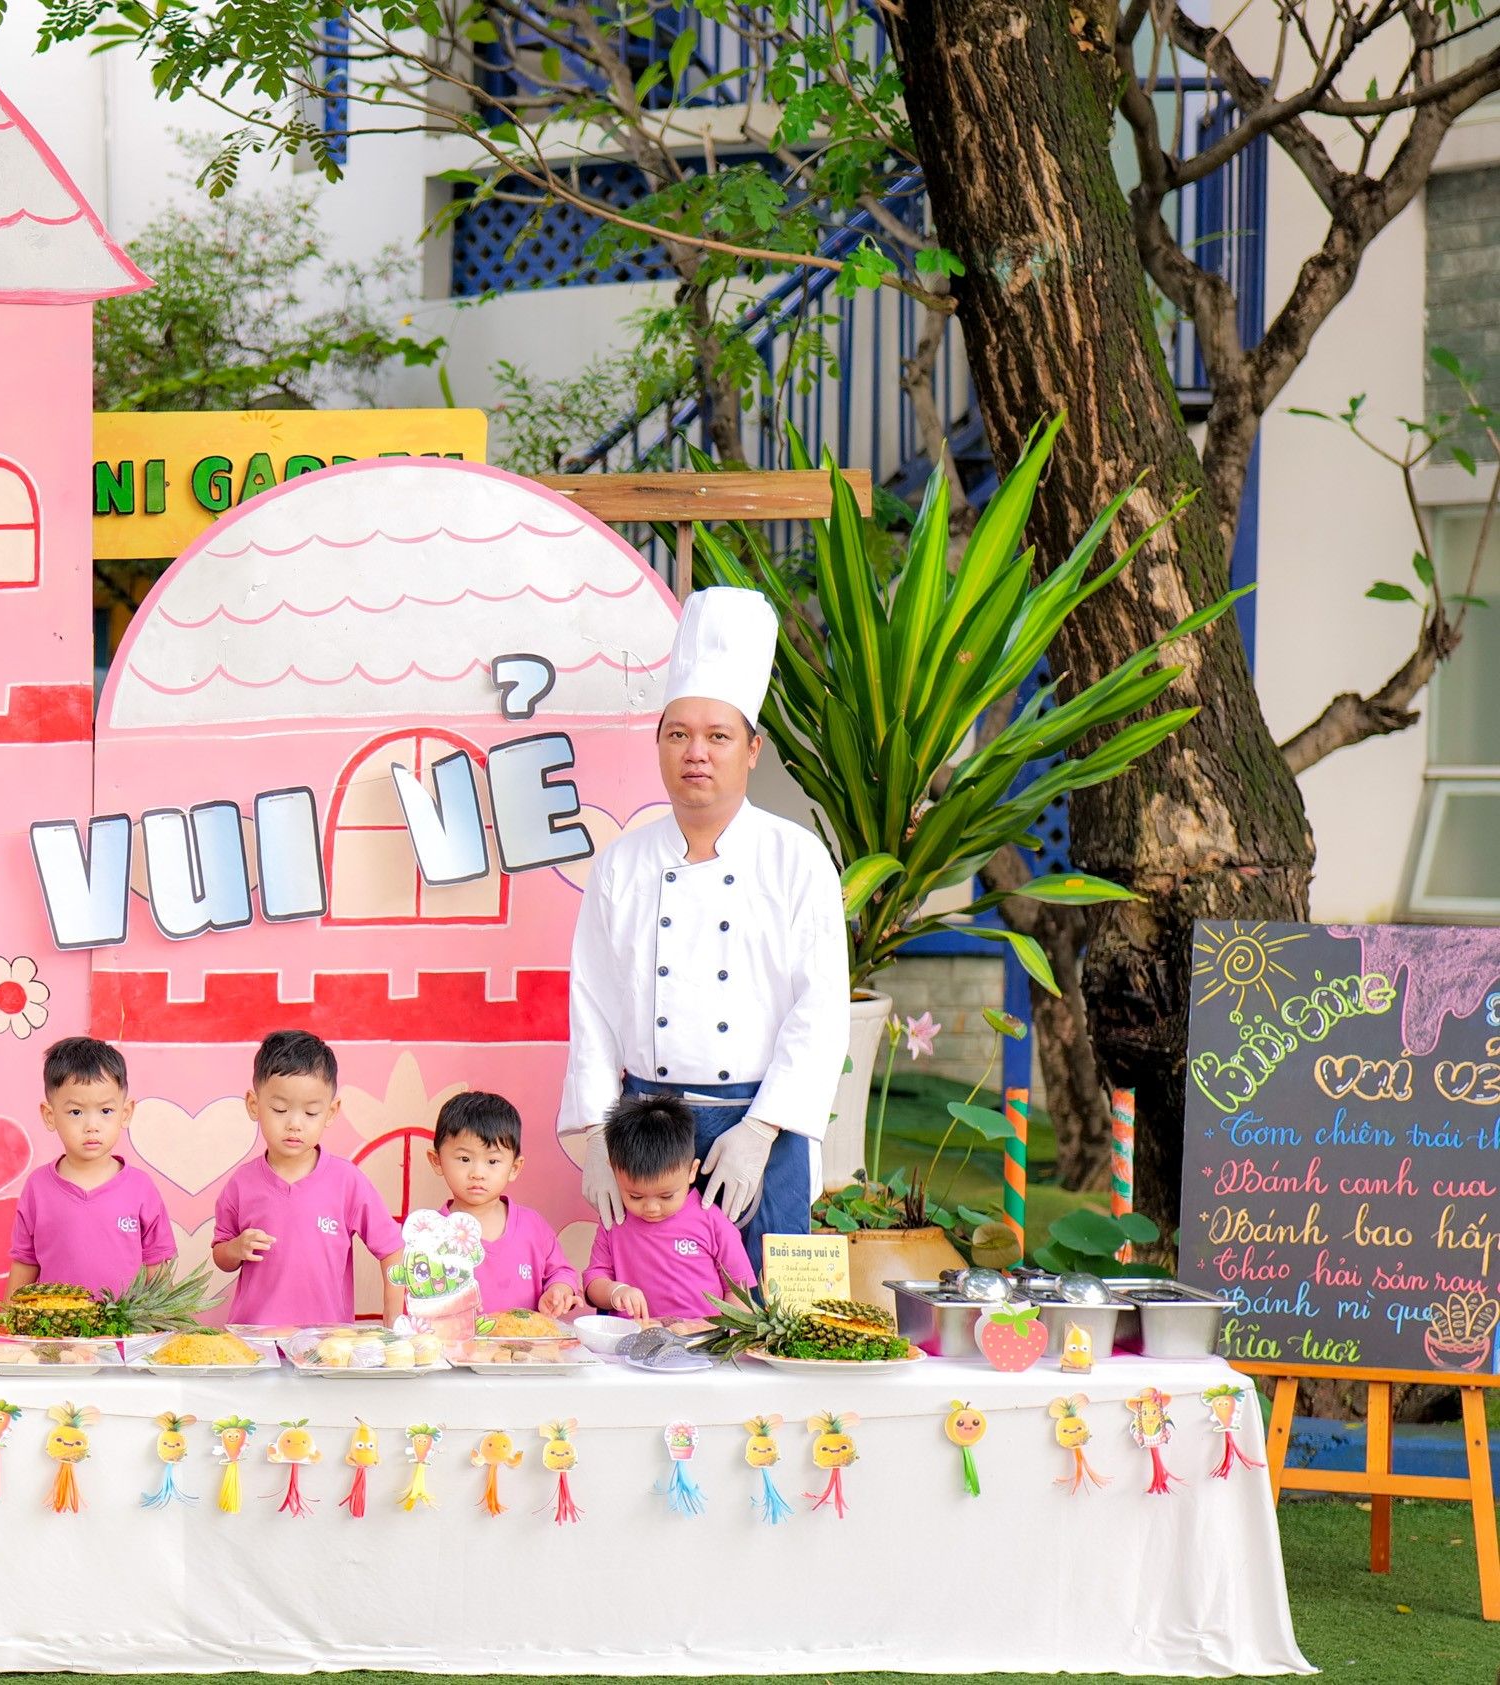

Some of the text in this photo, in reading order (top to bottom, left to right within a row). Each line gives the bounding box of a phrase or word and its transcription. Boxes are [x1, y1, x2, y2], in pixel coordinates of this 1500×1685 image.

[30, 786, 327, 950] VUI
[391, 654, 595, 886] VẺ
[1314, 1107, 1396, 1147] chiên
[1214, 1156, 1496, 1197] Bánh canh cua
[1208, 1202, 1330, 1245] Bánh
[1342, 1203, 1413, 1246] bao
[1307, 1249, 1362, 1286] hải
[1215, 1281, 1320, 1317] Bánh
[1337, 1290, 1376, 1320] mì
